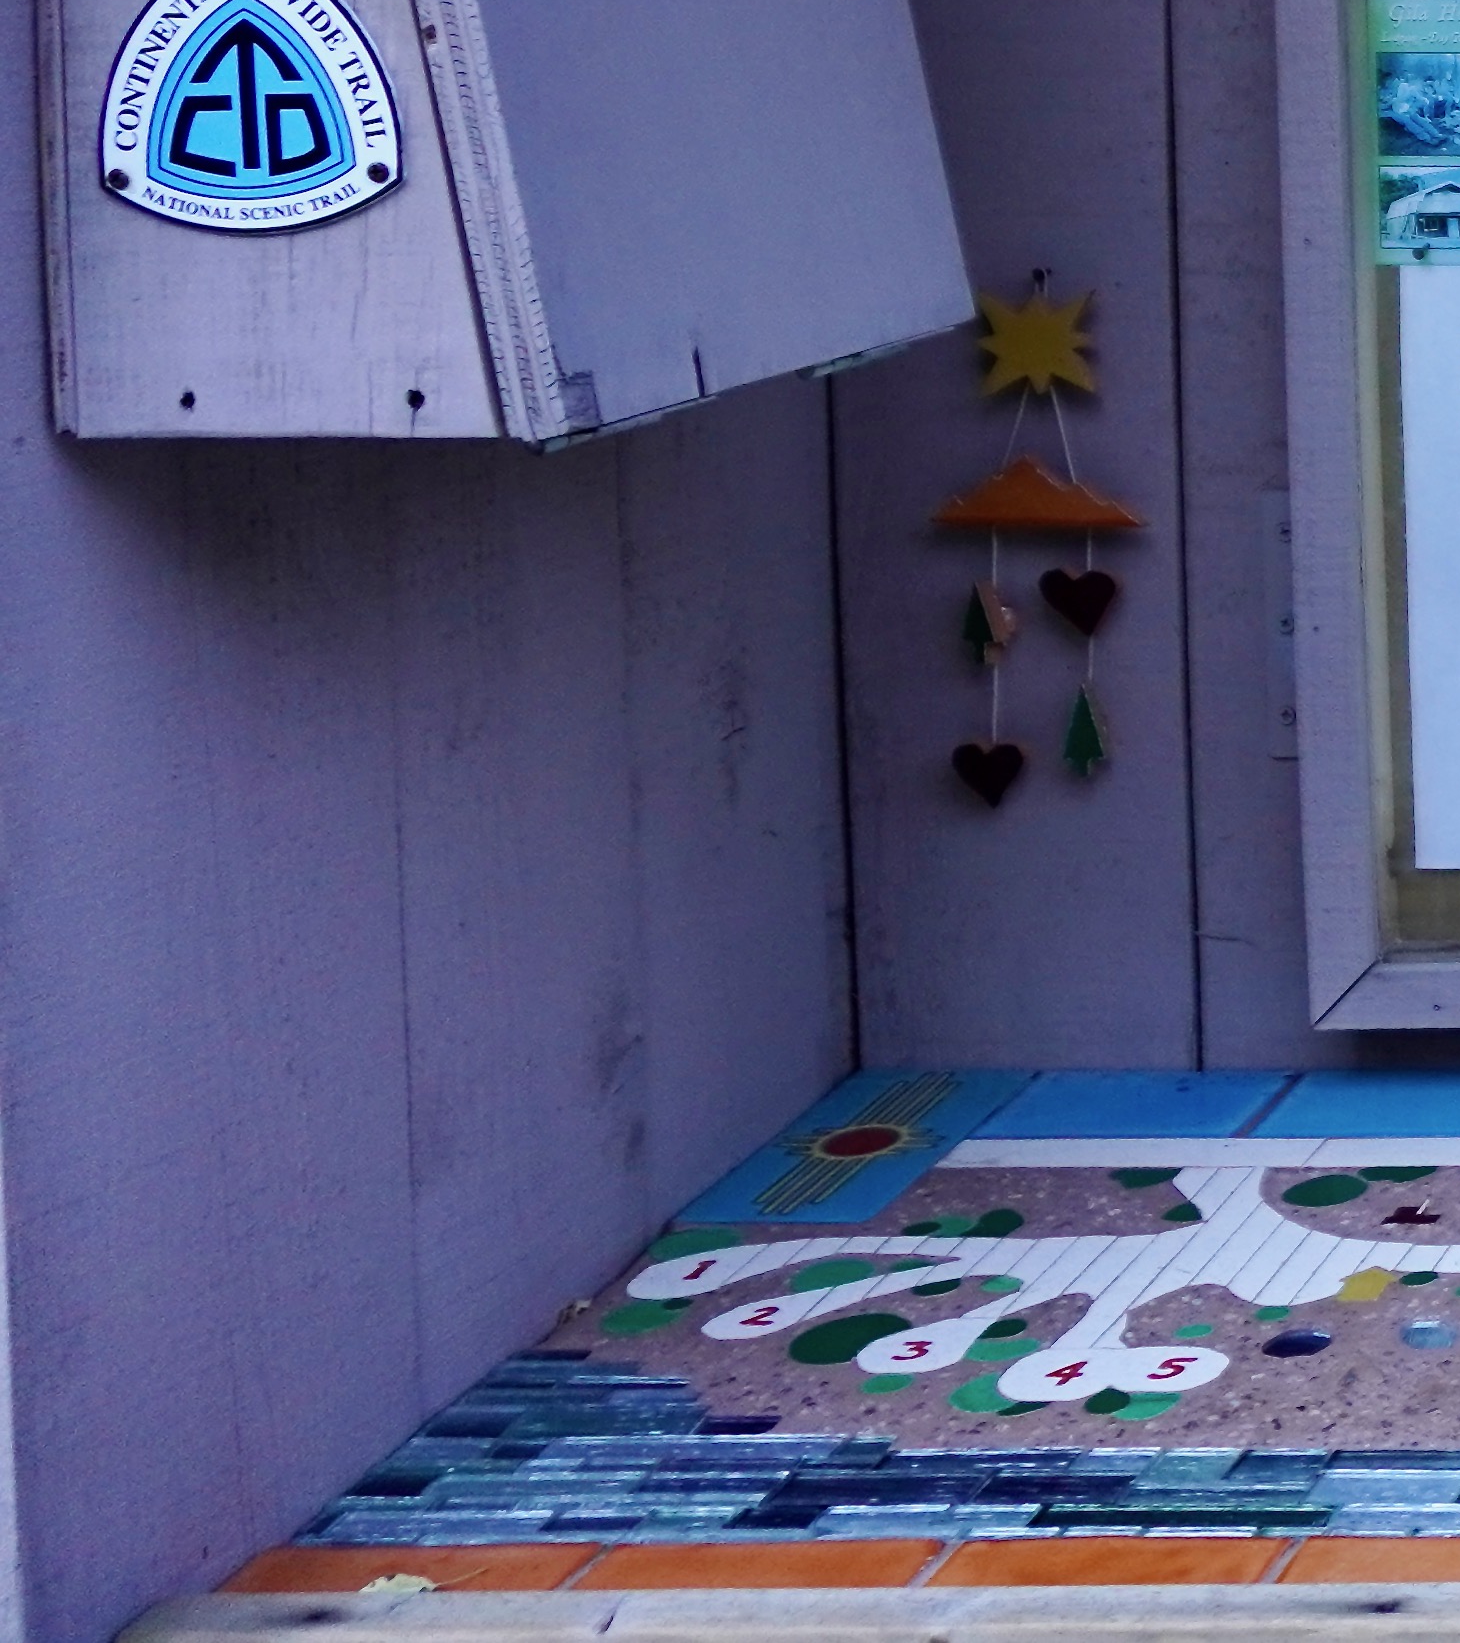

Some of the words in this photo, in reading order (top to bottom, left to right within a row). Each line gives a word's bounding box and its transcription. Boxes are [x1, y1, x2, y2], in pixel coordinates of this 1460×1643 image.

[338, 50, 388, 149] TRAIL
[141, 185, 236, 221] NATIONAL
[239, 201, 306, 222] SCENIC
[310, 182, 362, 213] TRAIL
[681, 1259, 719, 1281] 1
[737, 1305, 782, 1328] 2
[889, 1339, 935, 1363] 3
[1044, 1360, 1087, 1386] 4
[1146, 1355, 1199, 1380] 5
